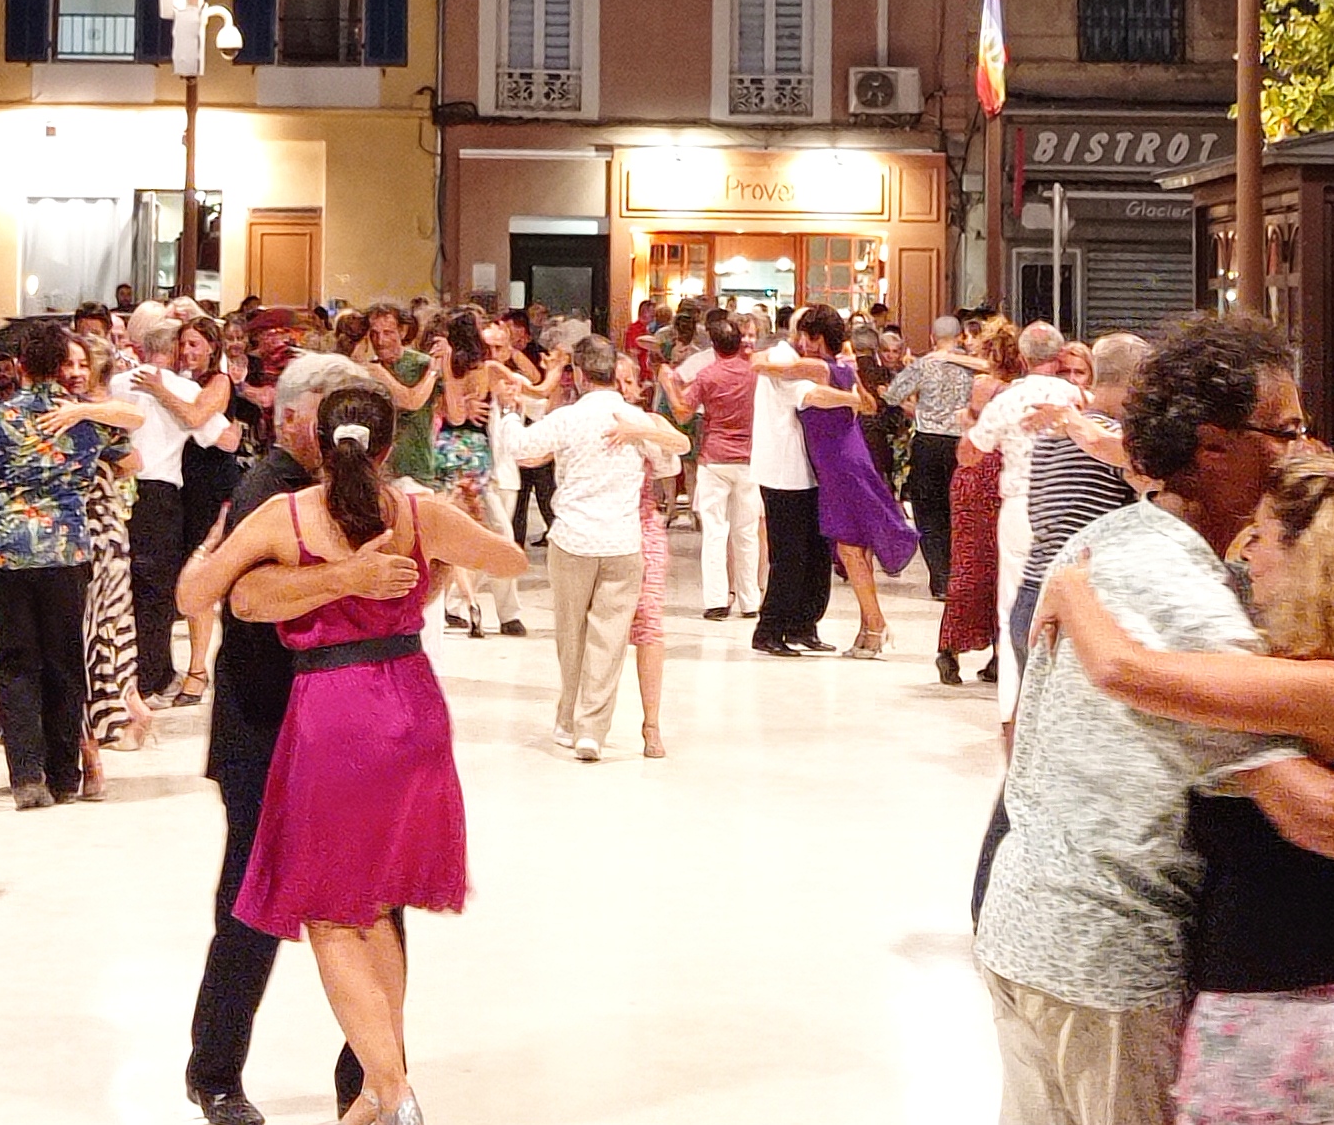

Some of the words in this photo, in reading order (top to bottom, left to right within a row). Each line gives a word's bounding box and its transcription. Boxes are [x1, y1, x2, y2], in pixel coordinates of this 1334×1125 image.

[1033, 131, 1218, 164] BISTROT
[726, 174, 795, 203] Prove
[1125, 200, 1192, 219] Glacier
